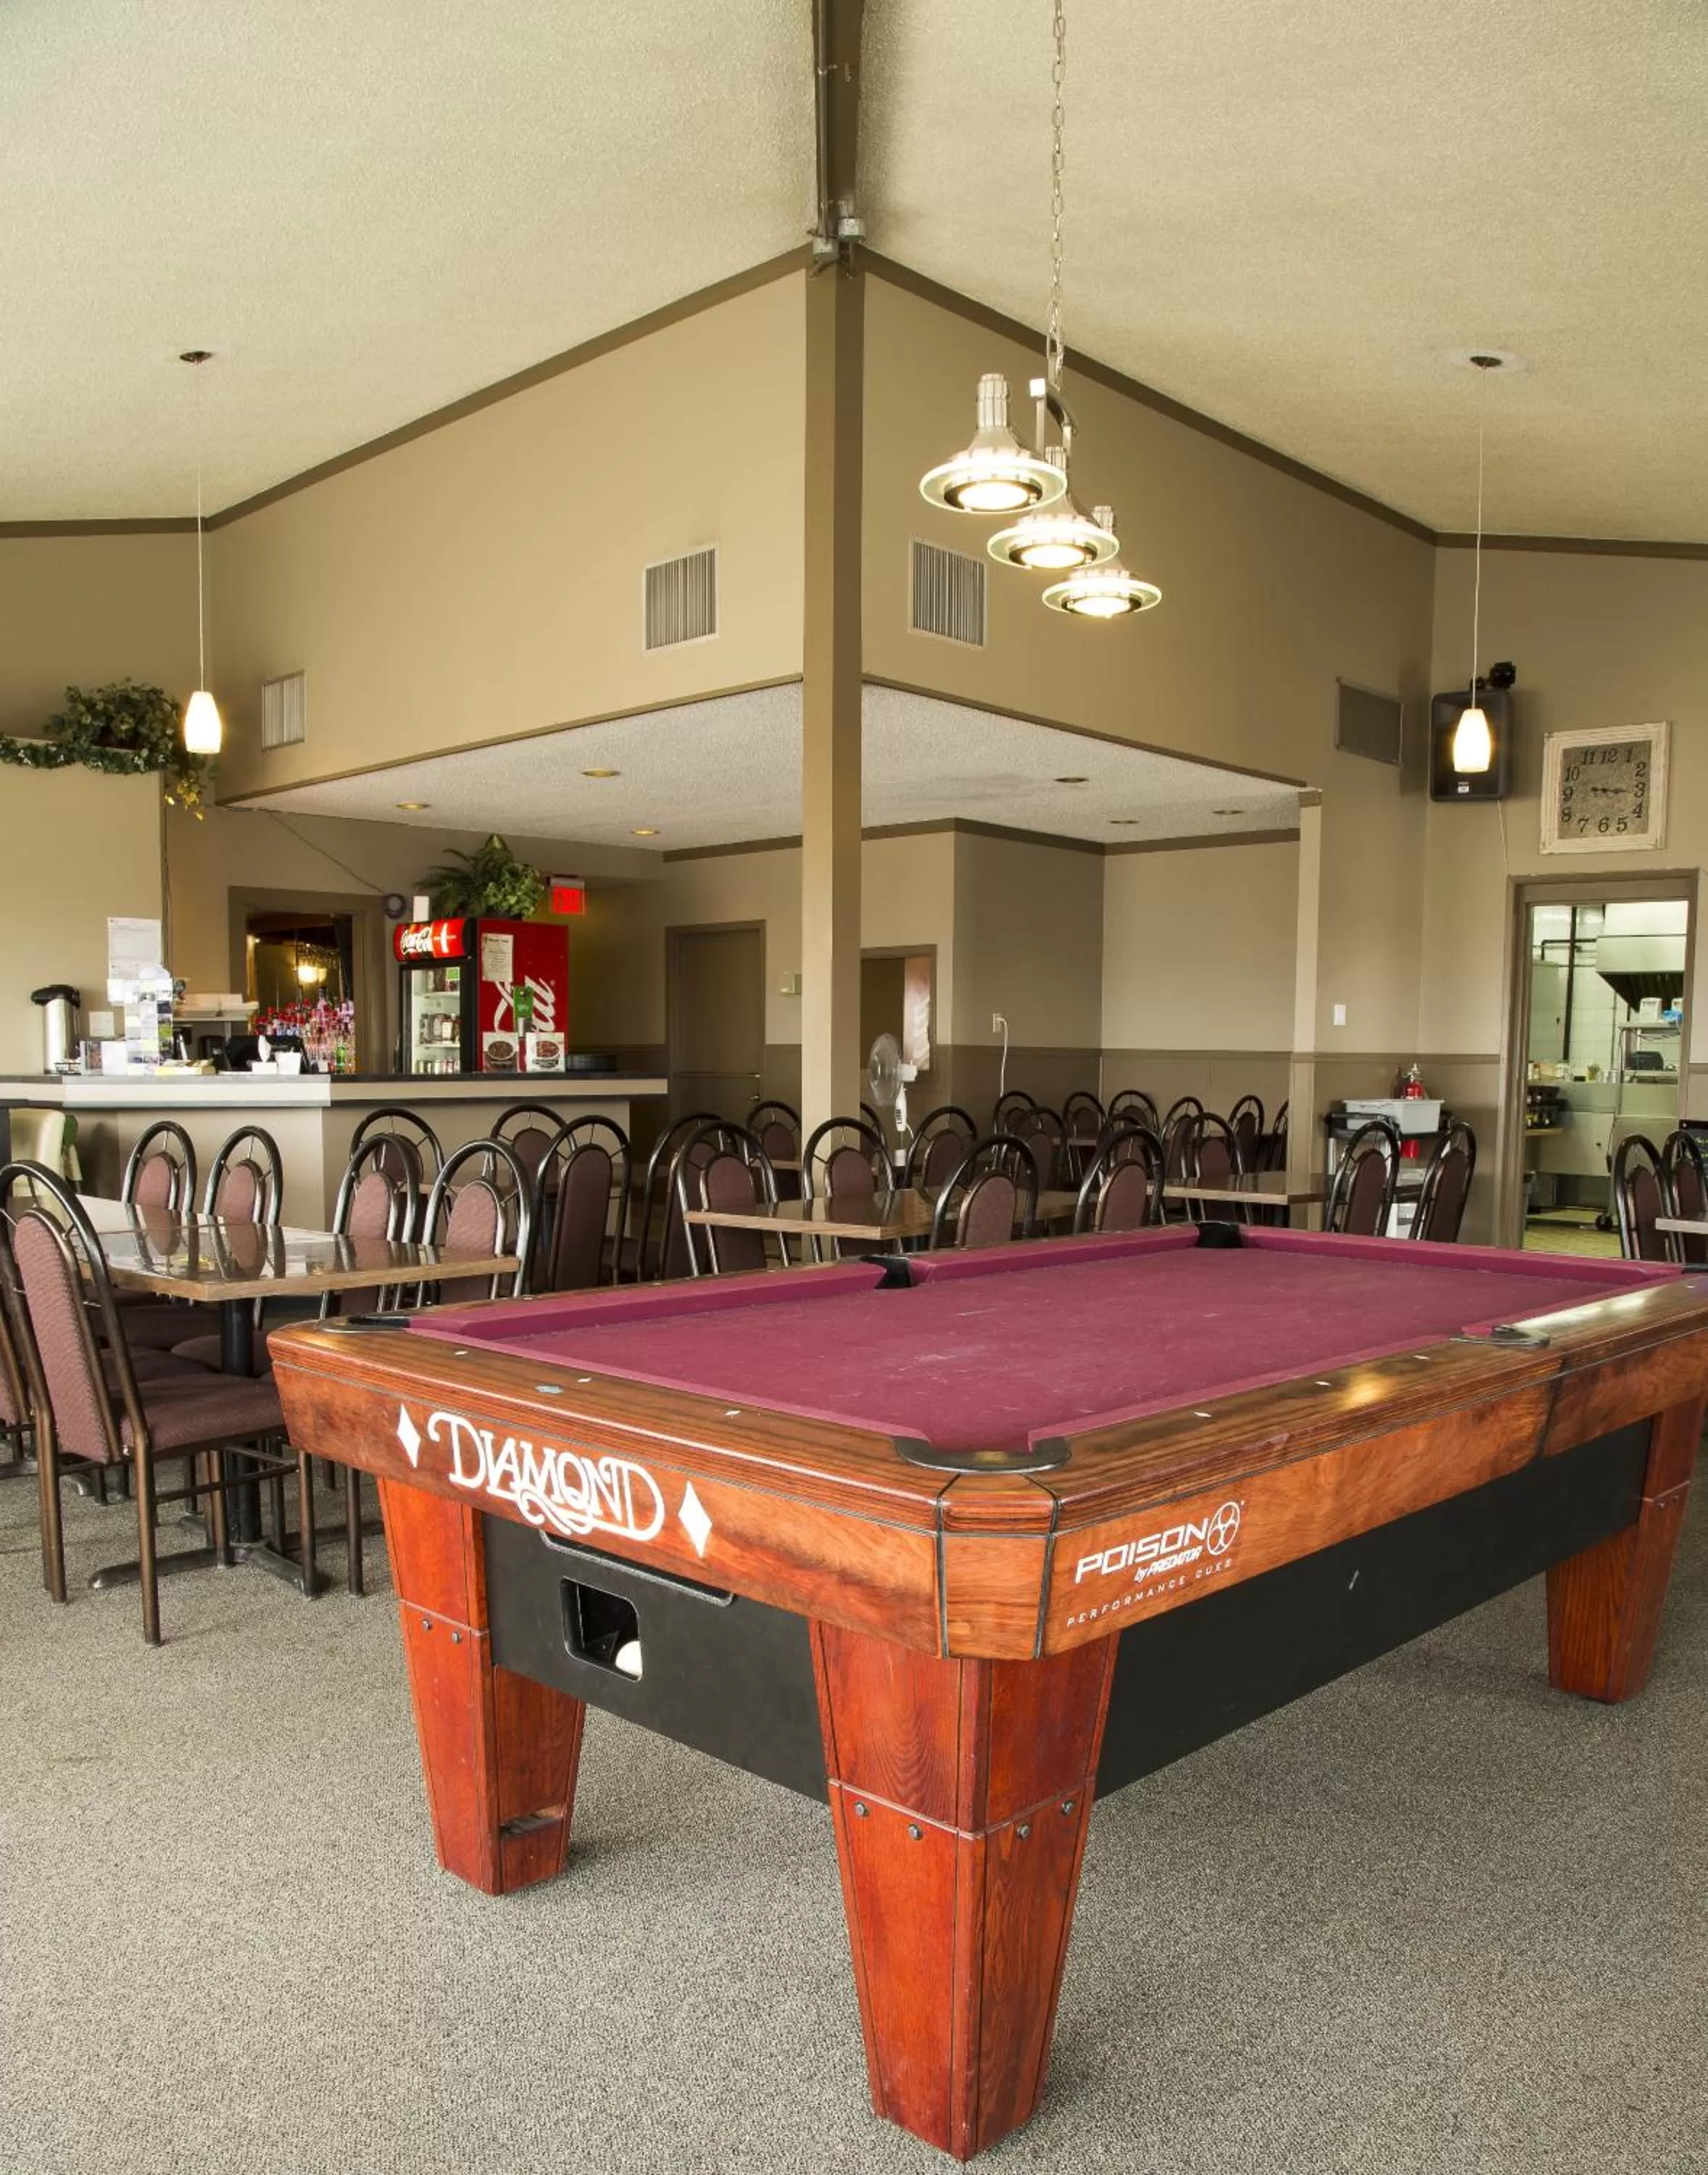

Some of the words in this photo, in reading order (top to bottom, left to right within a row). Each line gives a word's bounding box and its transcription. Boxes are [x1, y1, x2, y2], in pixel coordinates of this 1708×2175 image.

[1582, 750, 1595, 765] 11
[1599, 747, 1617, 764] 12
[1625, 747, 1634, 763] 1
[1564, 766, 1580, 782] 10
[1635, 762, 1646, 777] 2
[1562, 787, 1574, 802] 9
[1634, 782, 1646, 798] 3
[1561, 807, 1572, 823] 8
[1632, 801, 1643, 819] 4
[1578, 819, 1589, 833] 7
[1599, 817, 1609, 833] 6
[1616, 816, 1628, 832] 5
[427, 1412, 665, 1541] DIAMOND
[1074, 1517, 1209, 1584] POISON
[1066, 1575, 1186, 1628] PERFORMANCE
[1195, 1558, 1232, 1578] CUES
